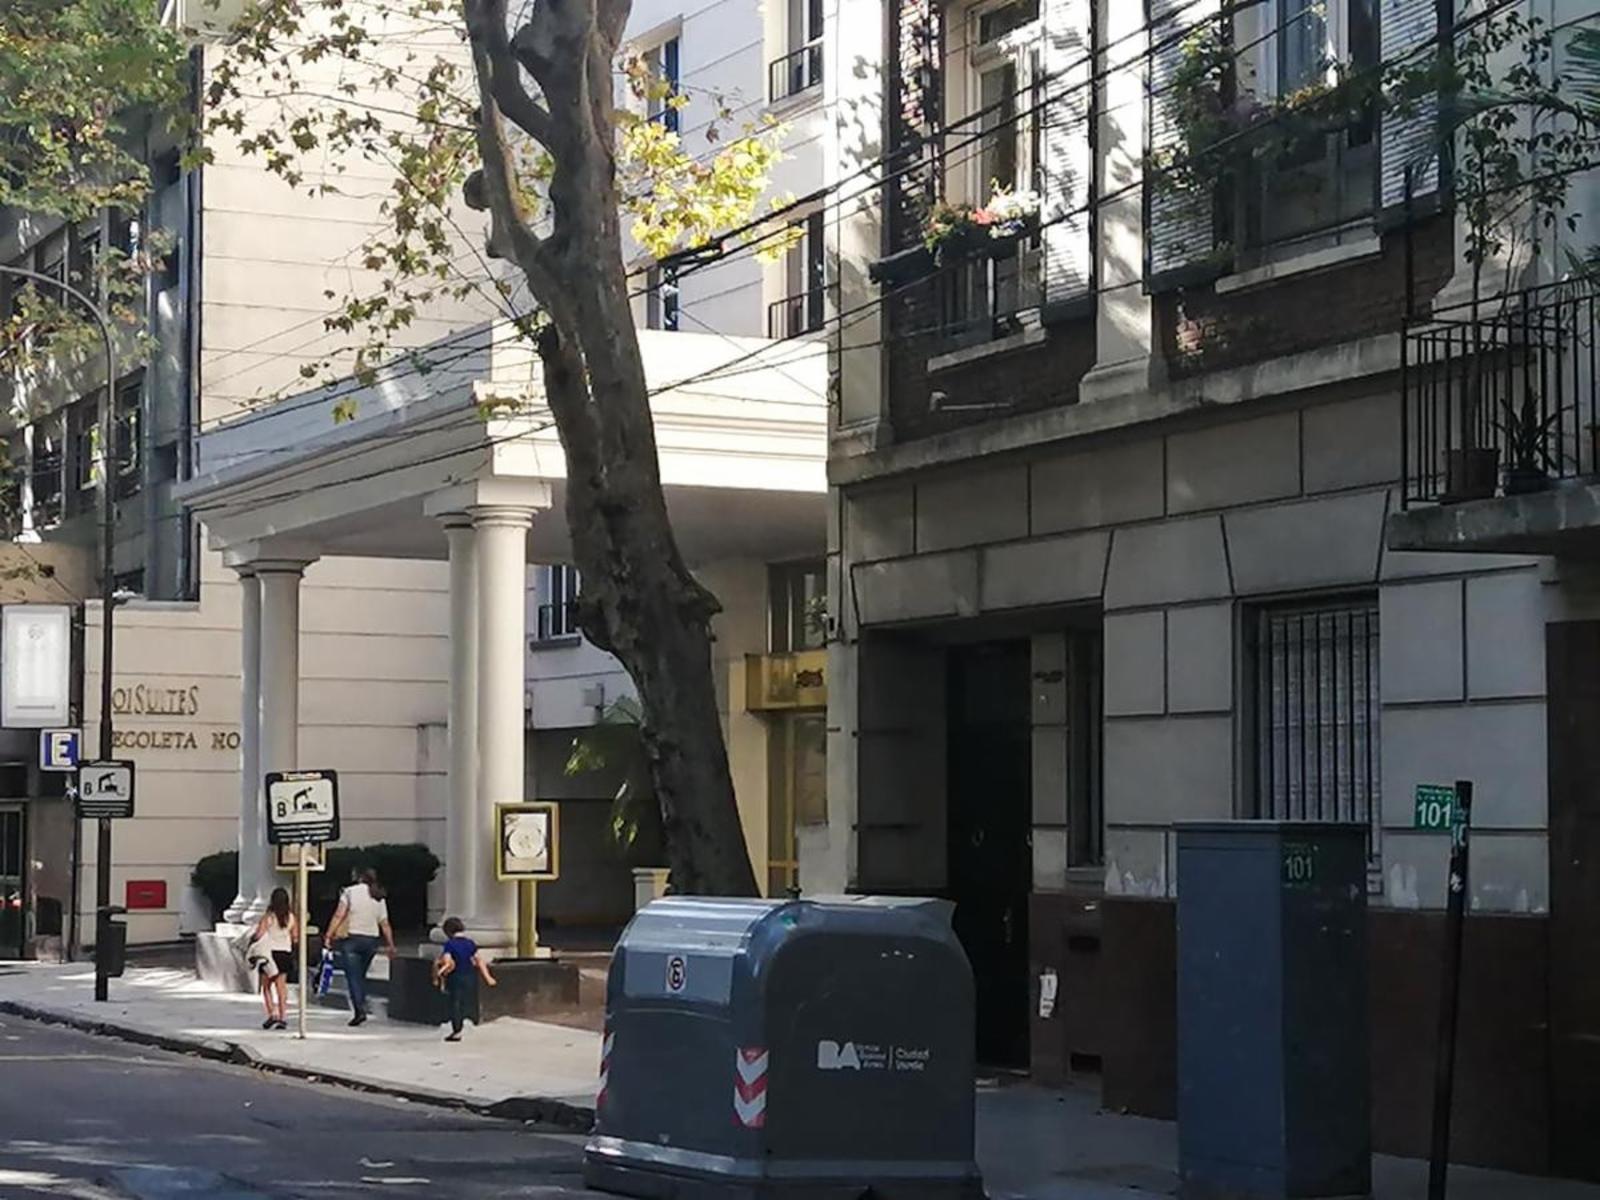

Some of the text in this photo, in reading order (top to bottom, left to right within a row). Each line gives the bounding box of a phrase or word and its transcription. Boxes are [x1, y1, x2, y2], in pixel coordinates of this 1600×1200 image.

[51, 732, 72, 766] E
[111, 731, 198, 749] ECOLETA
[1417, 801, 1451, 828] 101
[1285, 855, 1313, 880] 101
[817, 1040, 861, 1071] BA
